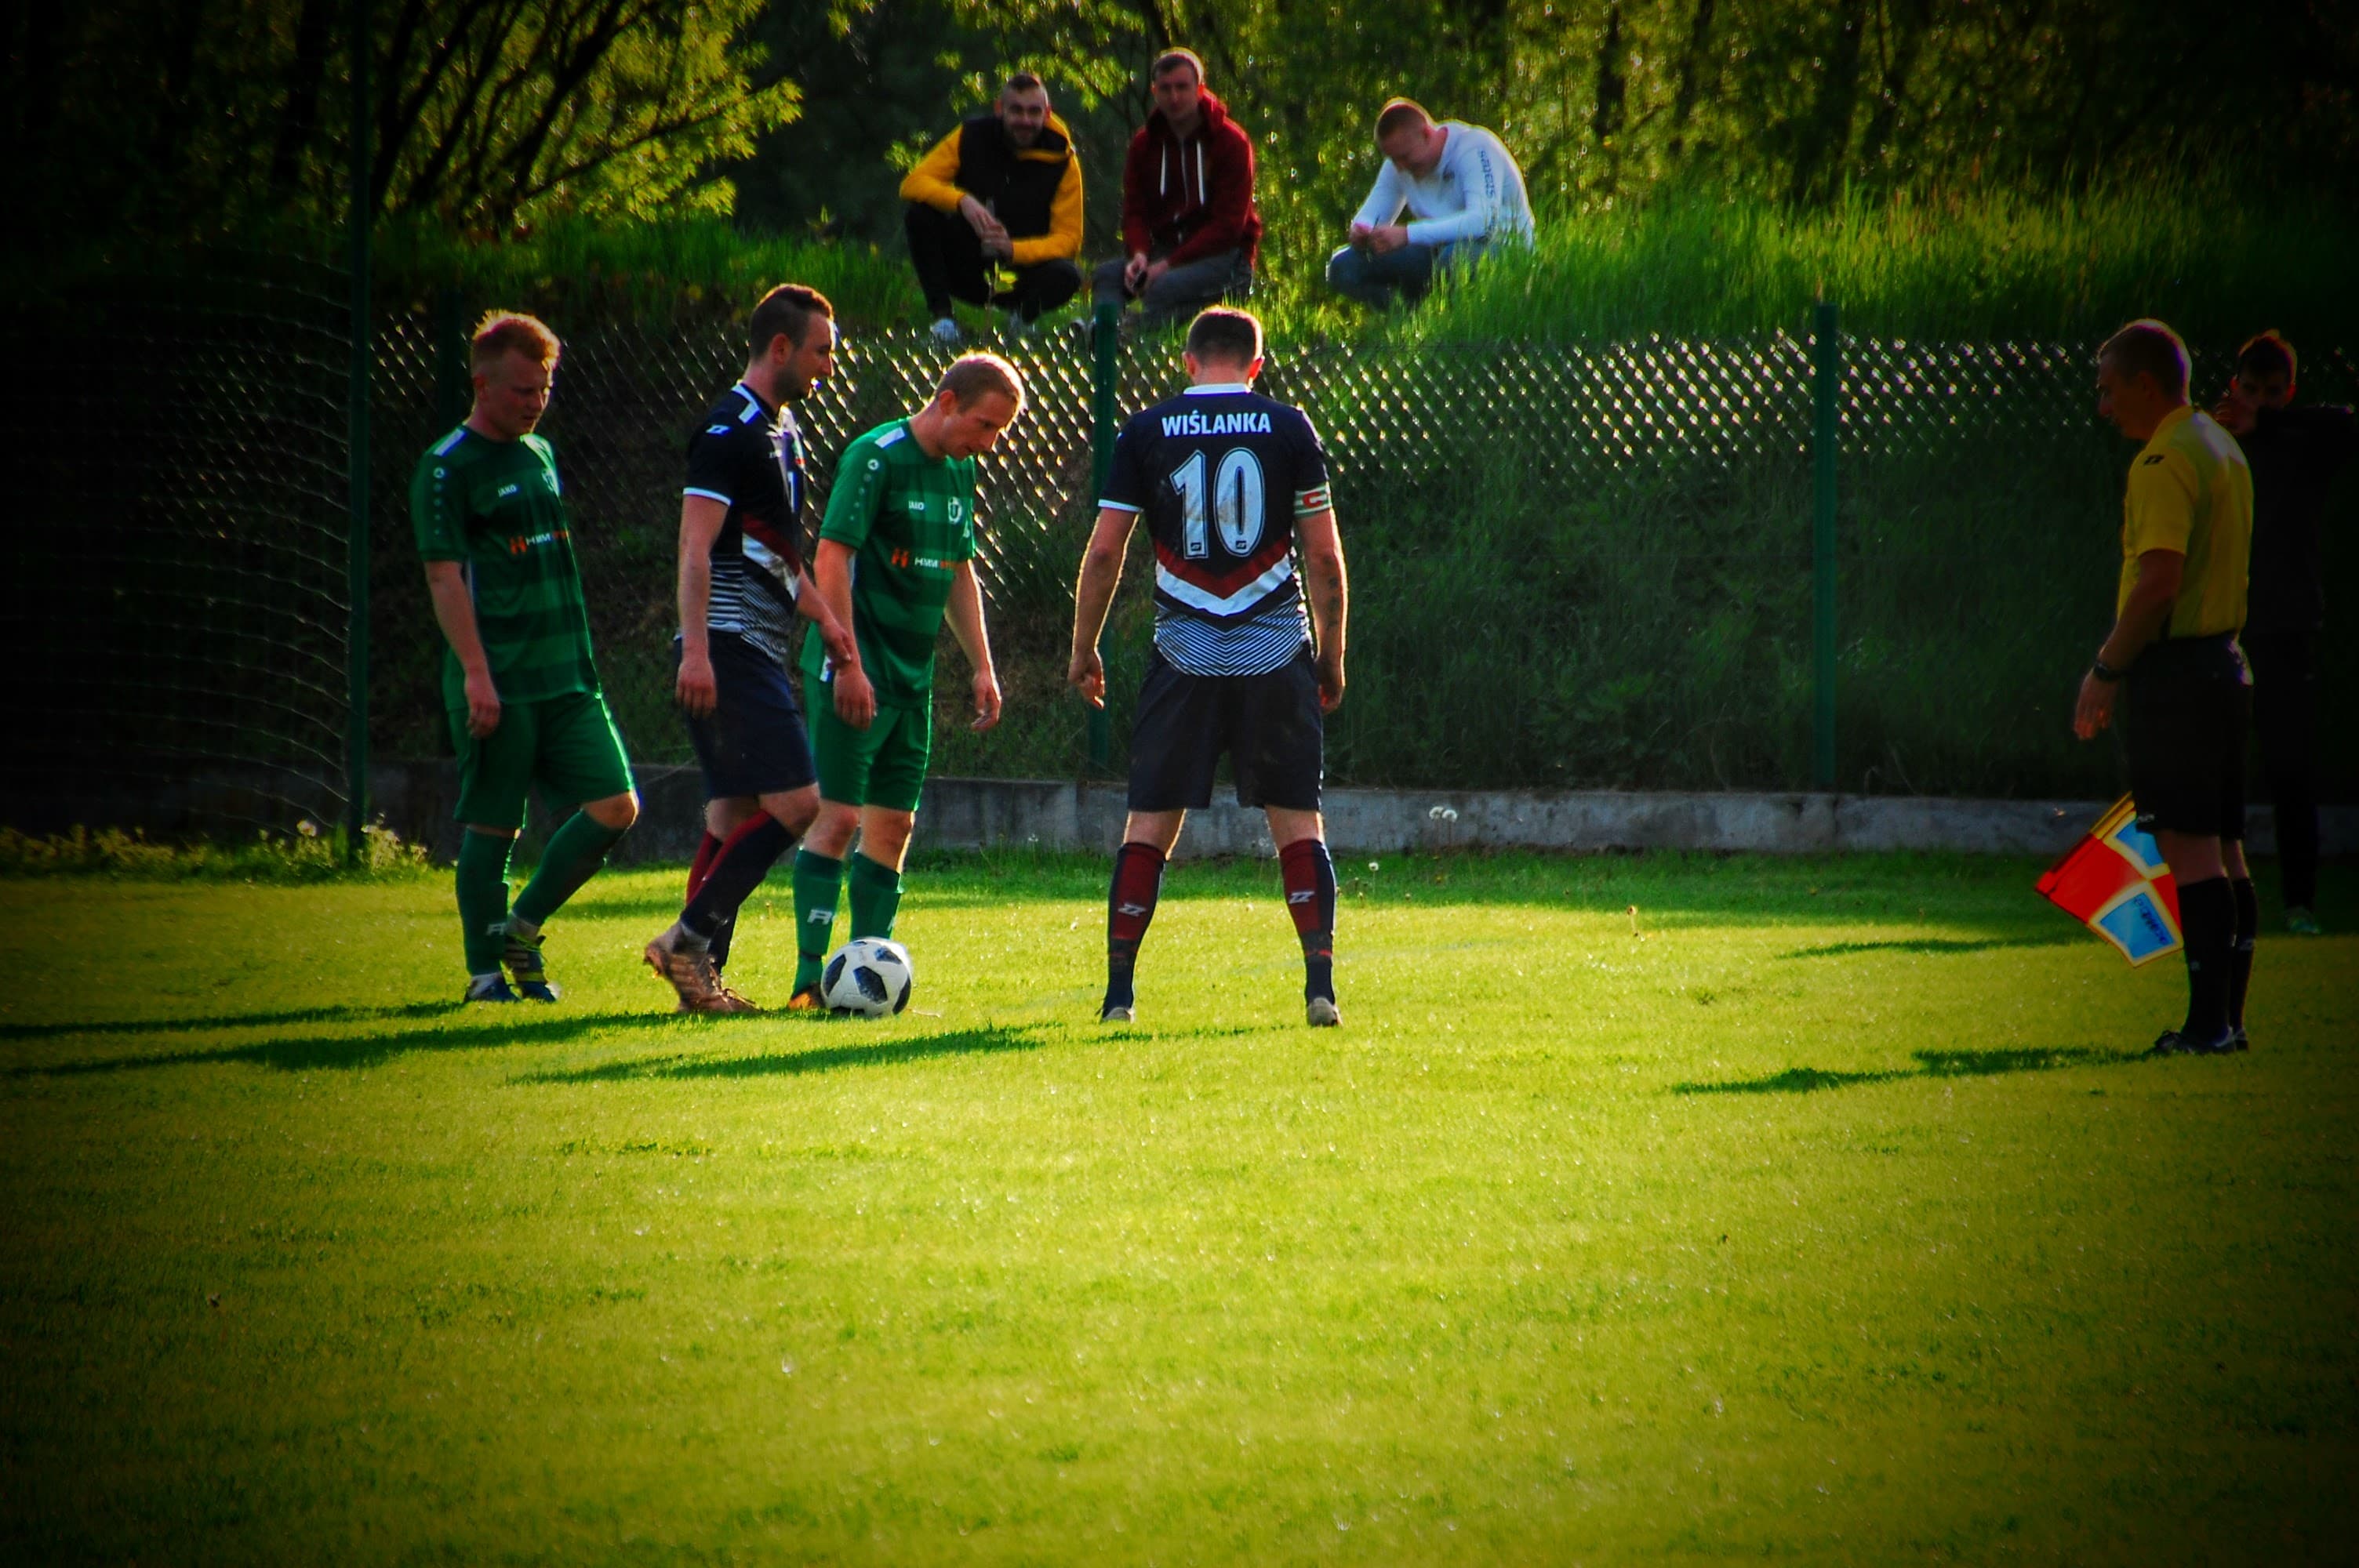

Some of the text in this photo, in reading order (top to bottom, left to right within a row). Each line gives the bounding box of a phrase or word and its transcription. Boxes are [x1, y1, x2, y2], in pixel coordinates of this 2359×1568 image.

[1161, 410, 1271, 437] WIŚLANKA
[1169, 447, 1265, 560] 10
[1303, 492, 1323, 509] C
